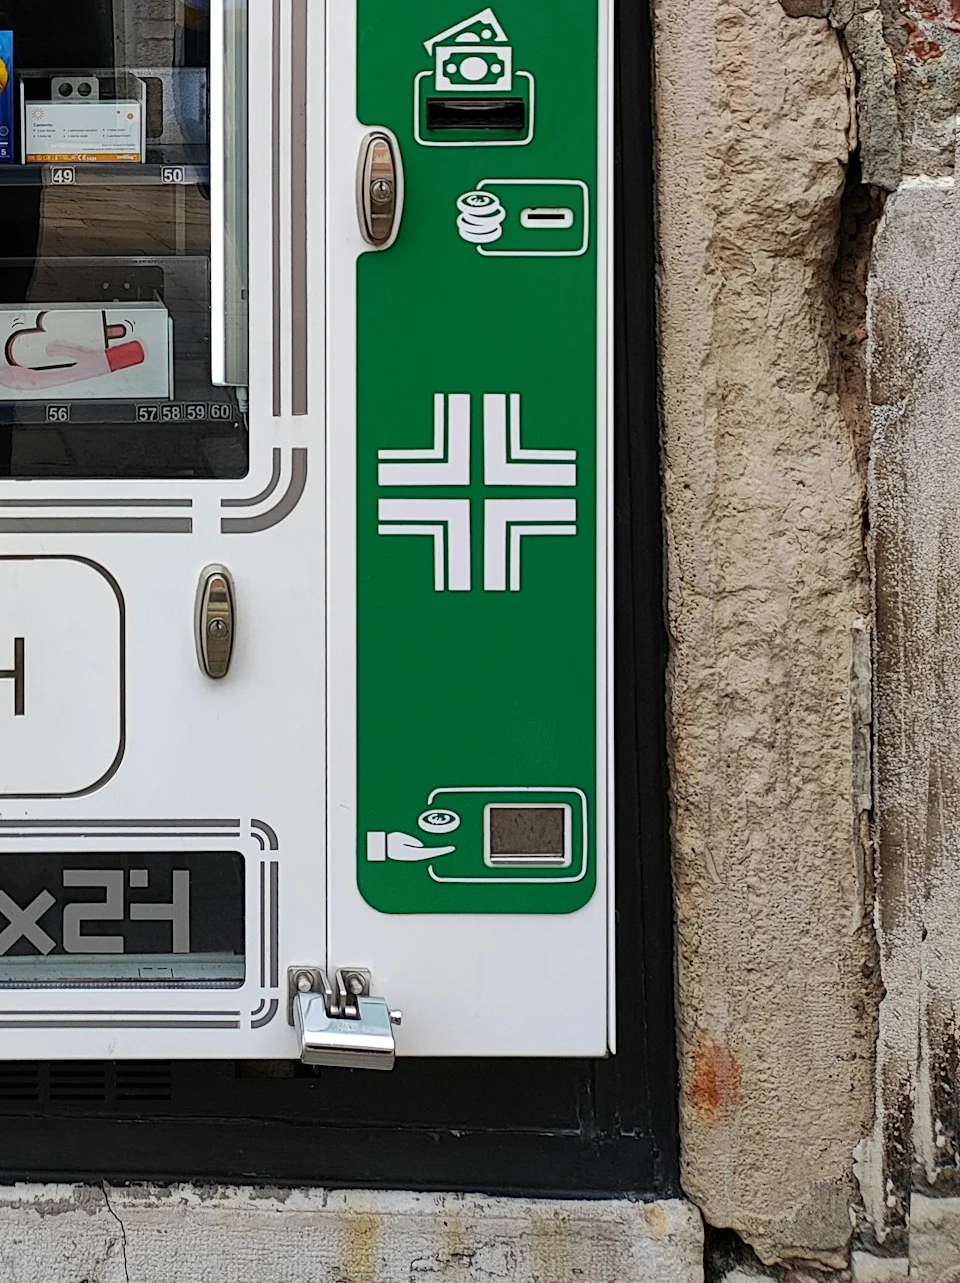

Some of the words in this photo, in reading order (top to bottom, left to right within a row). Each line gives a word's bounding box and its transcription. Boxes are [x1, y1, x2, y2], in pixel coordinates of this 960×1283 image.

[48, 406, 68, 421] 56
[138, 406, 157, 421] 57
[162, 406, 181, 420] 58
[186, 406, 205, 420] 59
[210, 404, 230, 419] 60
